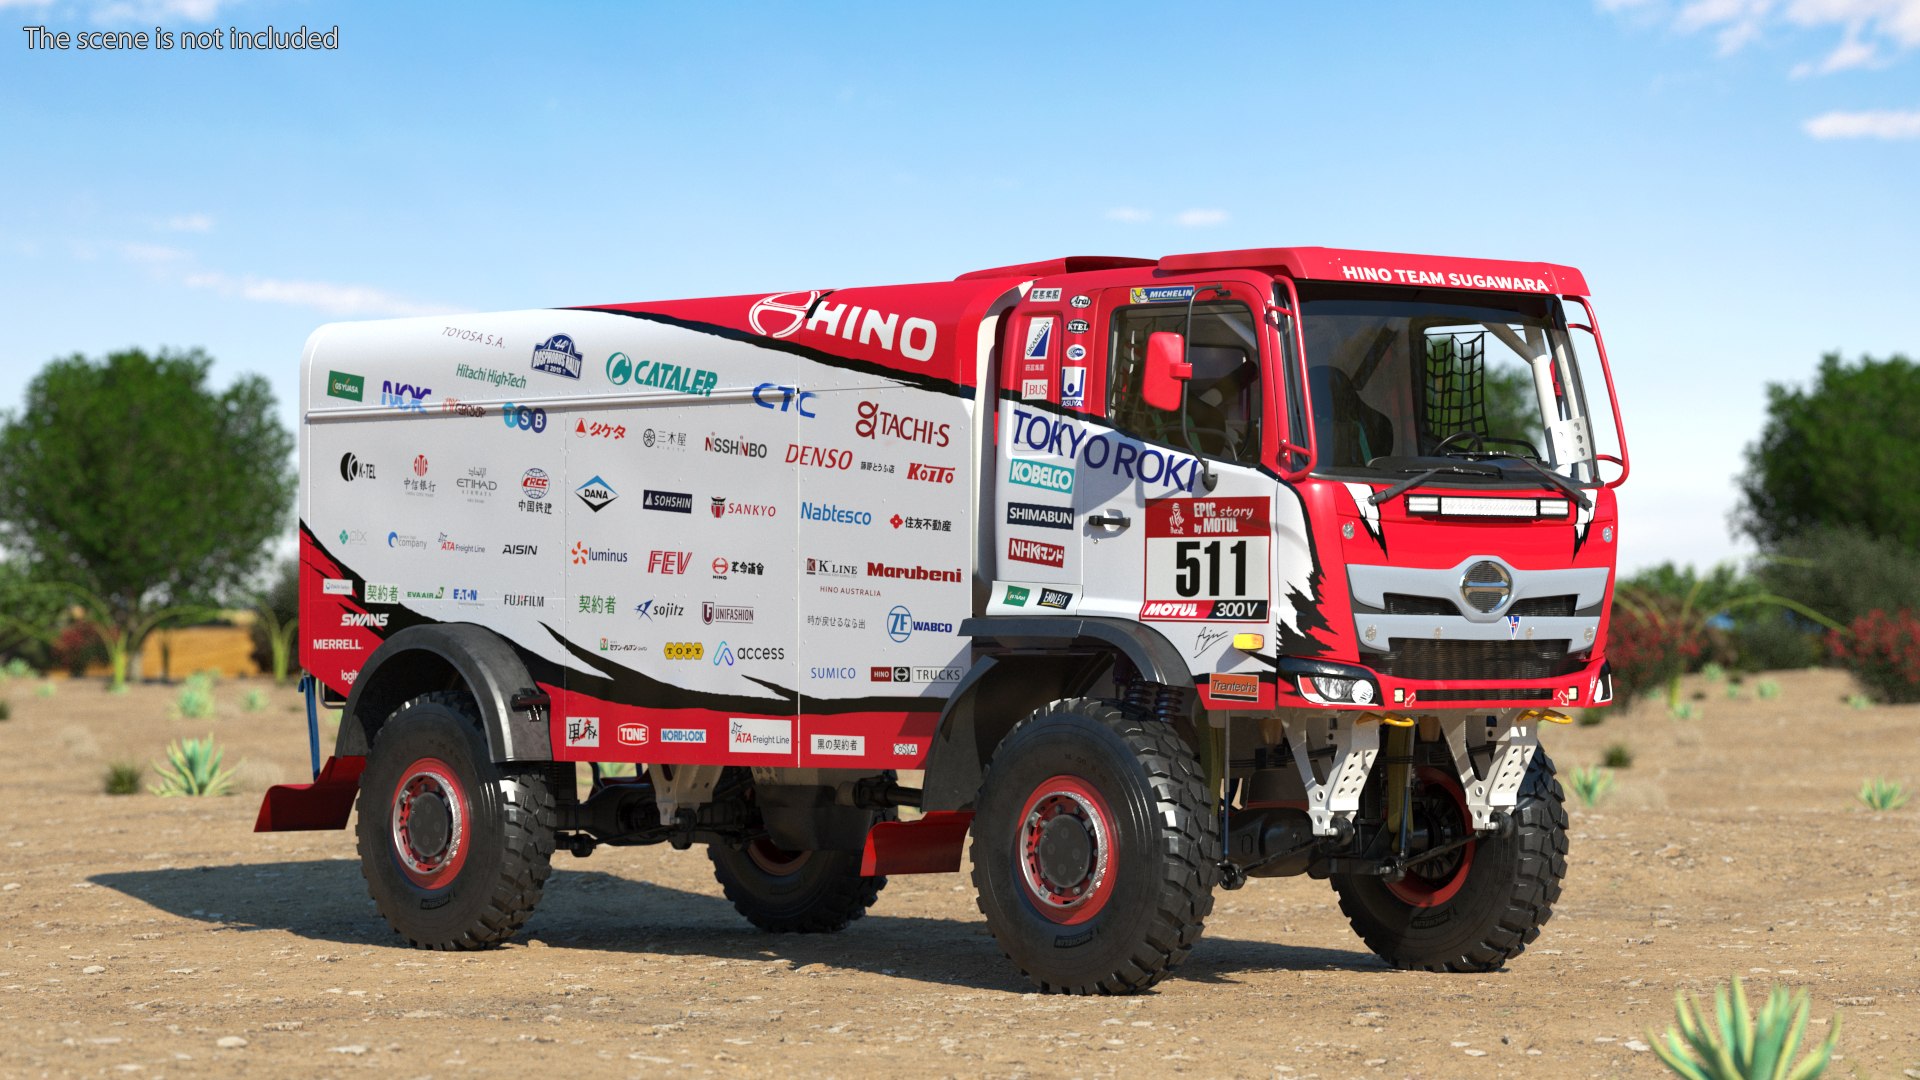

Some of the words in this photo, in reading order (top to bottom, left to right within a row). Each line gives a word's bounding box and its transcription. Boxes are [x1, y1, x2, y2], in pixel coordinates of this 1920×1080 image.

[1343, 265, 1392, 282] HINO
[1394, 268, 1446, 285] TEAM
[1448, 272, 1550, 292] SUGAWARA
[1150, 288, 1193, 298] MICHELIN
[442, 326, 484, 343] TOYOSA
[485, 334, 506, 349] S.A.
[805, 300, 937, 362] HINO
[1026, 321, 1050, 356] OKAMOTO
[456, 363, 488, 381] Hitachi
[488, 368, 527, 389] High-Tech
[549, 365, 562, 374] 2015
[634, 360, 718, 397] CATALER
[381, 380, 432, 414] NOK
[880, 411, 950, 448] TACHI-S
[657, 430, 687, 447] 三木屋
[785, 443, 853, 470] DENSO
[1013, 409, 1110, 469] TOKYO
[1112, 441, 1199, 493] ROKI
[1011, 460, 1073, 491] KOBELCO
[456, 478, 498, 491] ETIHAD
[584, 488, 609, 500] DANA
[653, 494, 692, 509] SOHSHIN
[727, 502, 776, 517] SANKYO
[800, 501, 872, 526] Nabtesco
[1009, 507, 1073, 525] SHIMABUN
[1193, 502, 1216, 518] EPIC
[1219, 506, 1254, 520] story
[904, 516, 952, 532] 住友不動産
[1193, 523, 1202, 534] by
[1203, 517, 1239, 533] MOTUL
[398, 538, 427, 550] company
[441, 541, 455, 551] ATA
[455, 543, 474, 553] Freight
[474, 544, 486, 553] Line
[502, 544, 538, 556] AISIN
[588, 547, 628, 563] luminus
[647, 550, 692, 575] FEV
[832, 564, 858, 575] LINE
[867, 561, 962, 583] Marubeni
[1175, 540, 1247, 598] 511
[367, 584, 399, 602] 契約者
[820, 585, 839, 594] HINO
[840, 587, 881, 597] AUSTRALIA
[1043, 591, 1068, 606] ENDLESS
[578, 594, 617, 614] 契約者
[653, 601, 685, 618] sojitz
[1144, 602, 1198, 617] MOTUL
[340, 613, 389, 627] SWANS
[715, 607, 754, 622] UNIFASHION
[889, 613, 911, 635] ZF
[912, 620, 952, 633] WABCO
[313, 638, 362, 650] MERRELL
[667, 647, 701, 655] TOPY
[737, 646, 785, 660] access
[810, 667, 856, 679] SUMICO
[916, 669, 960, 681] TRUCKS
[1212, 679, 1257, 693] Trantechs
[620, 727, 647, 741] TONE
[662, 730, 705, 742] NORD-LOCK
[735, 732, 752, 743] ATA
[752, 734, 775, 746] Freight
[776, 735, 790, 745] Line
[817, 738, 858, 751] 黒の契約者
